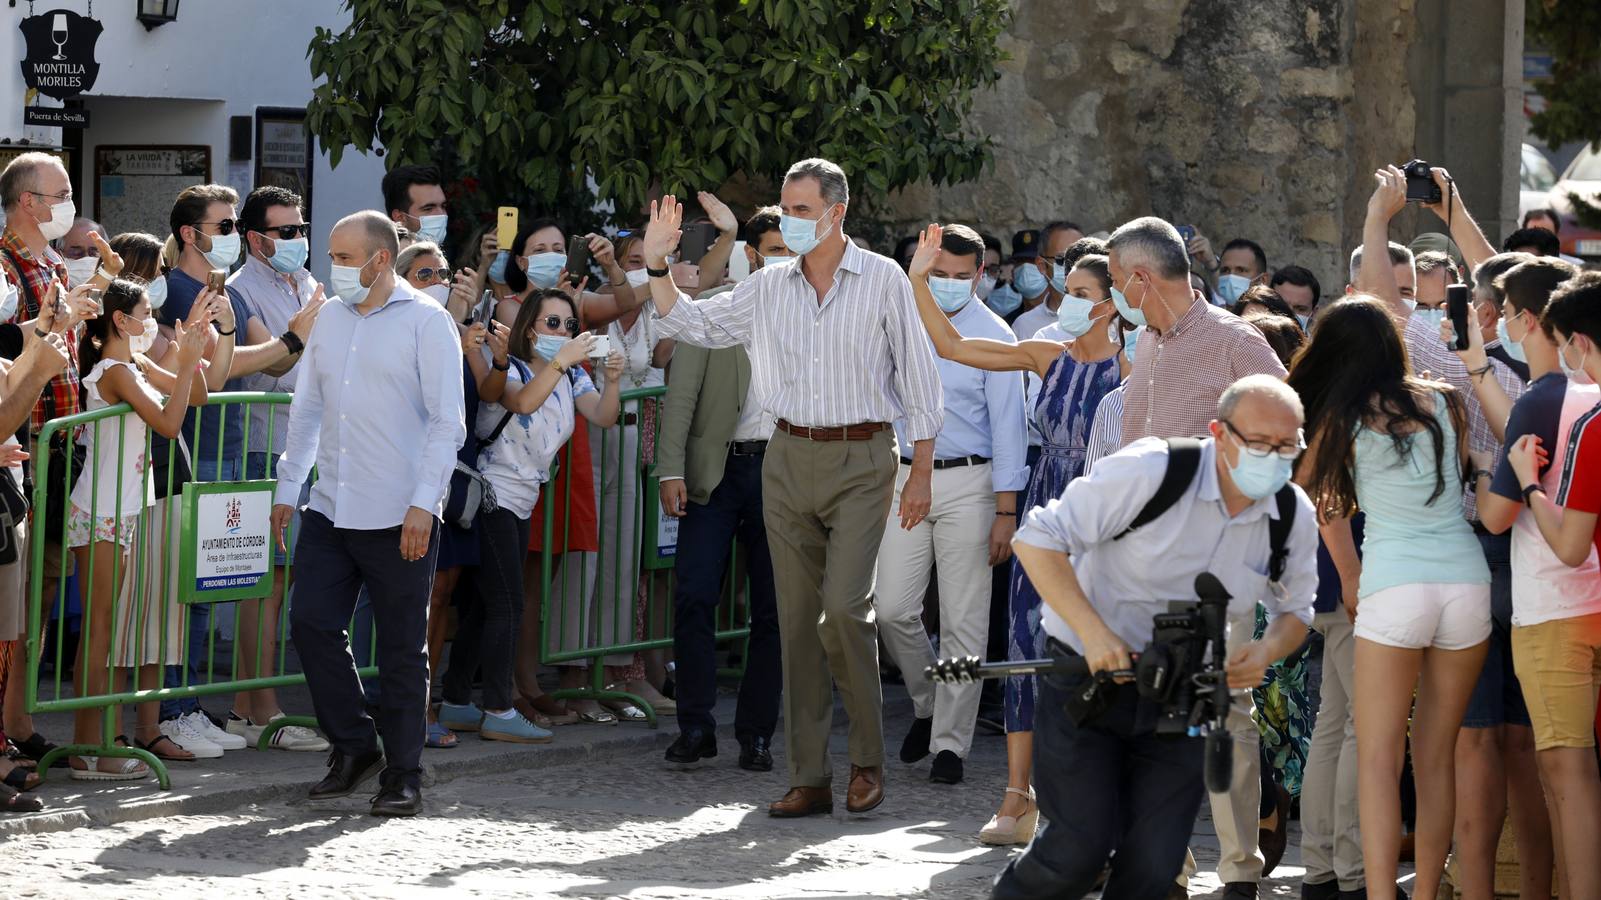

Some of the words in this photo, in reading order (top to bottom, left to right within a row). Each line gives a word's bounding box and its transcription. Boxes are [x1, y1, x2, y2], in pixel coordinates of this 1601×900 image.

[33, 63, 86, 74] MONTILLA
[37, 76, 82, 87] MORILES
[29, 111, 52, 120] Puerta
[53, 112, 62, 121] de
[63, 113, 85, 122] Sevilla
[126, 153, 136, 161] LA
[201, 537, 236, 550] AYUNTAMIENTO
[236, 537, 242, 548] DE
[218, 553, 226, 562] de
[215, 565, 229, 574] Equipo
[227, 577, 237, 586] LAS
